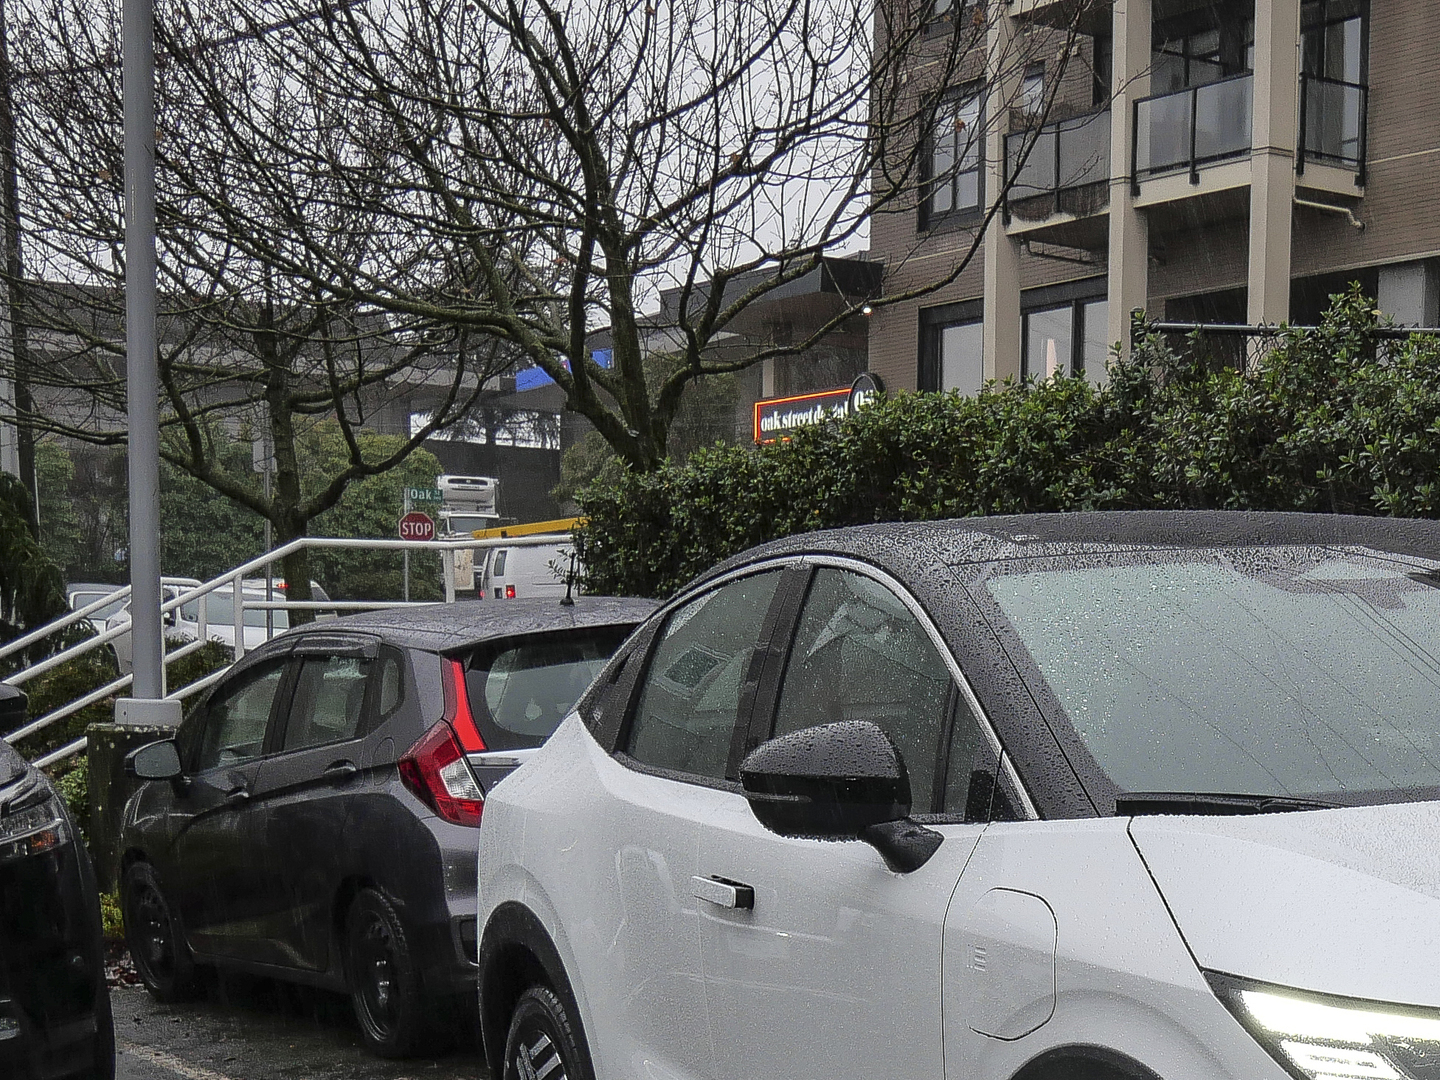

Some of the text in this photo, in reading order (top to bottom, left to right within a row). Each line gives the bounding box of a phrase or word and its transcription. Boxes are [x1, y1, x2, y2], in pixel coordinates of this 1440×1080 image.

[760, 410, 782, 432] oak
[782, 407, 814, 429] street
[410, 488, 432, 500] Oak
[401, 522, 432, 536] STOP
